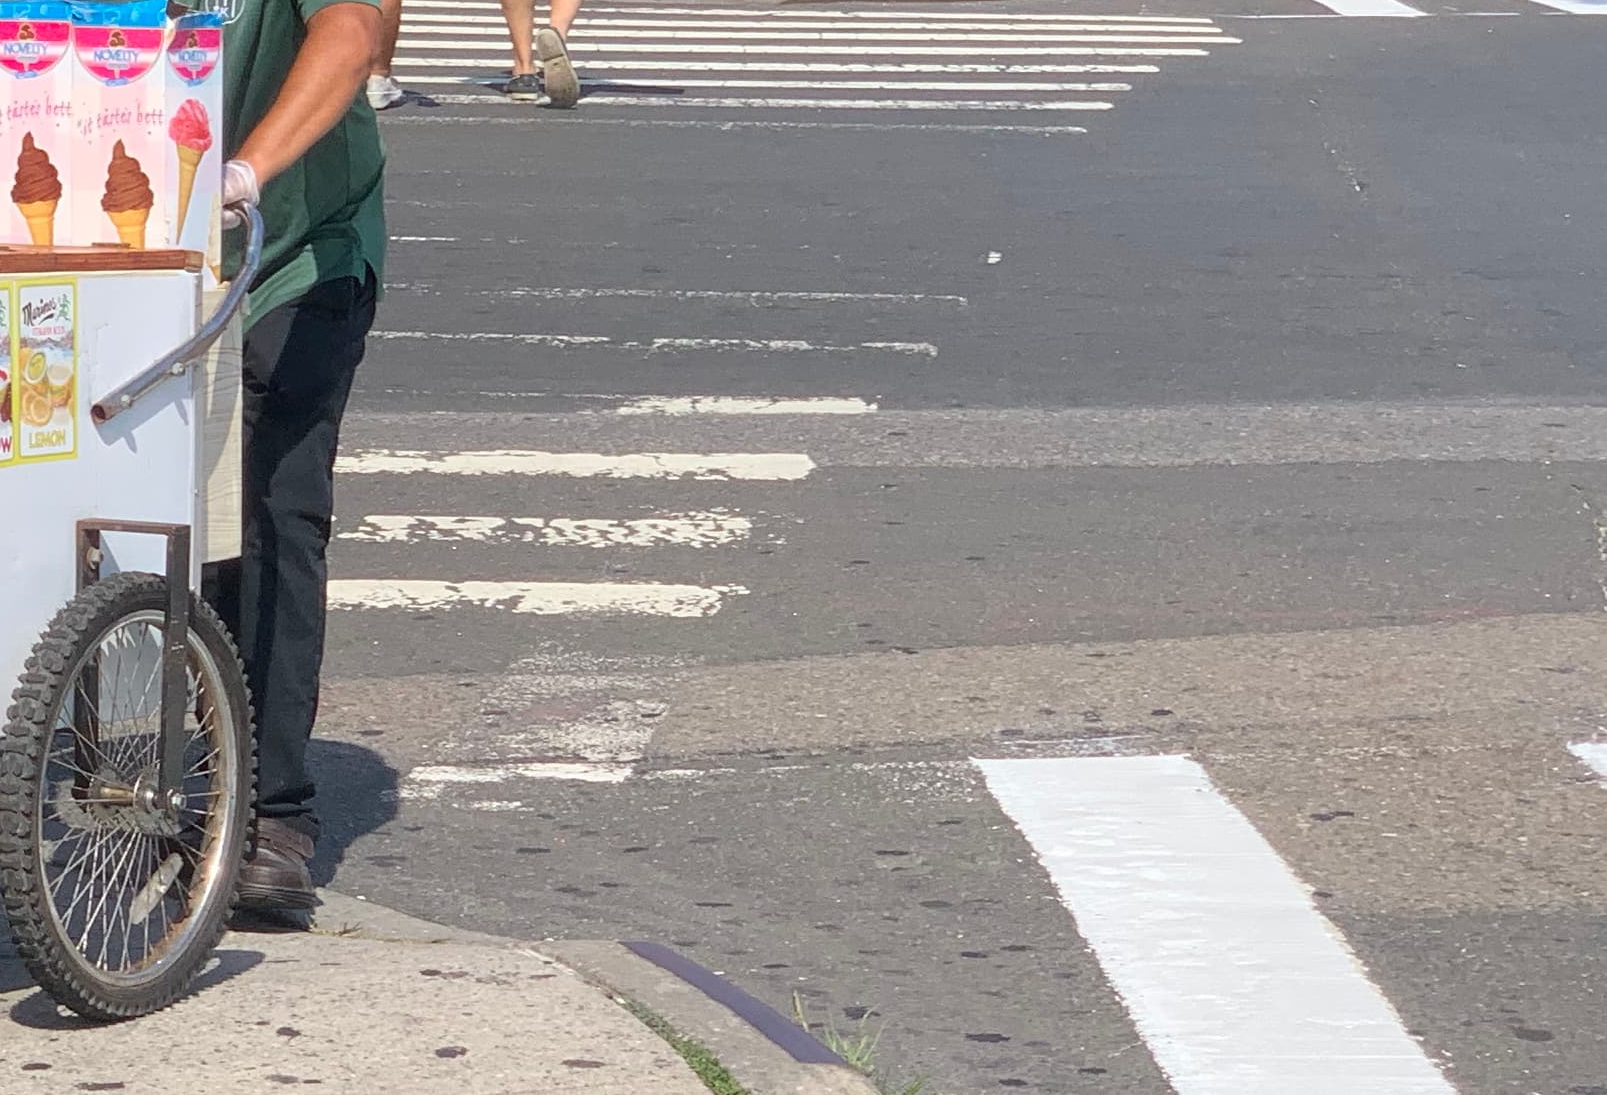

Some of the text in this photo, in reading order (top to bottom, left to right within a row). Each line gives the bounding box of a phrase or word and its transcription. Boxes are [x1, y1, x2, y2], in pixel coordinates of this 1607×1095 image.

[3, 42, 48, 56] NOVELTY
[94, 49, 139, 62] NOVELTY
[29, 429, 66, 449] LEMON
